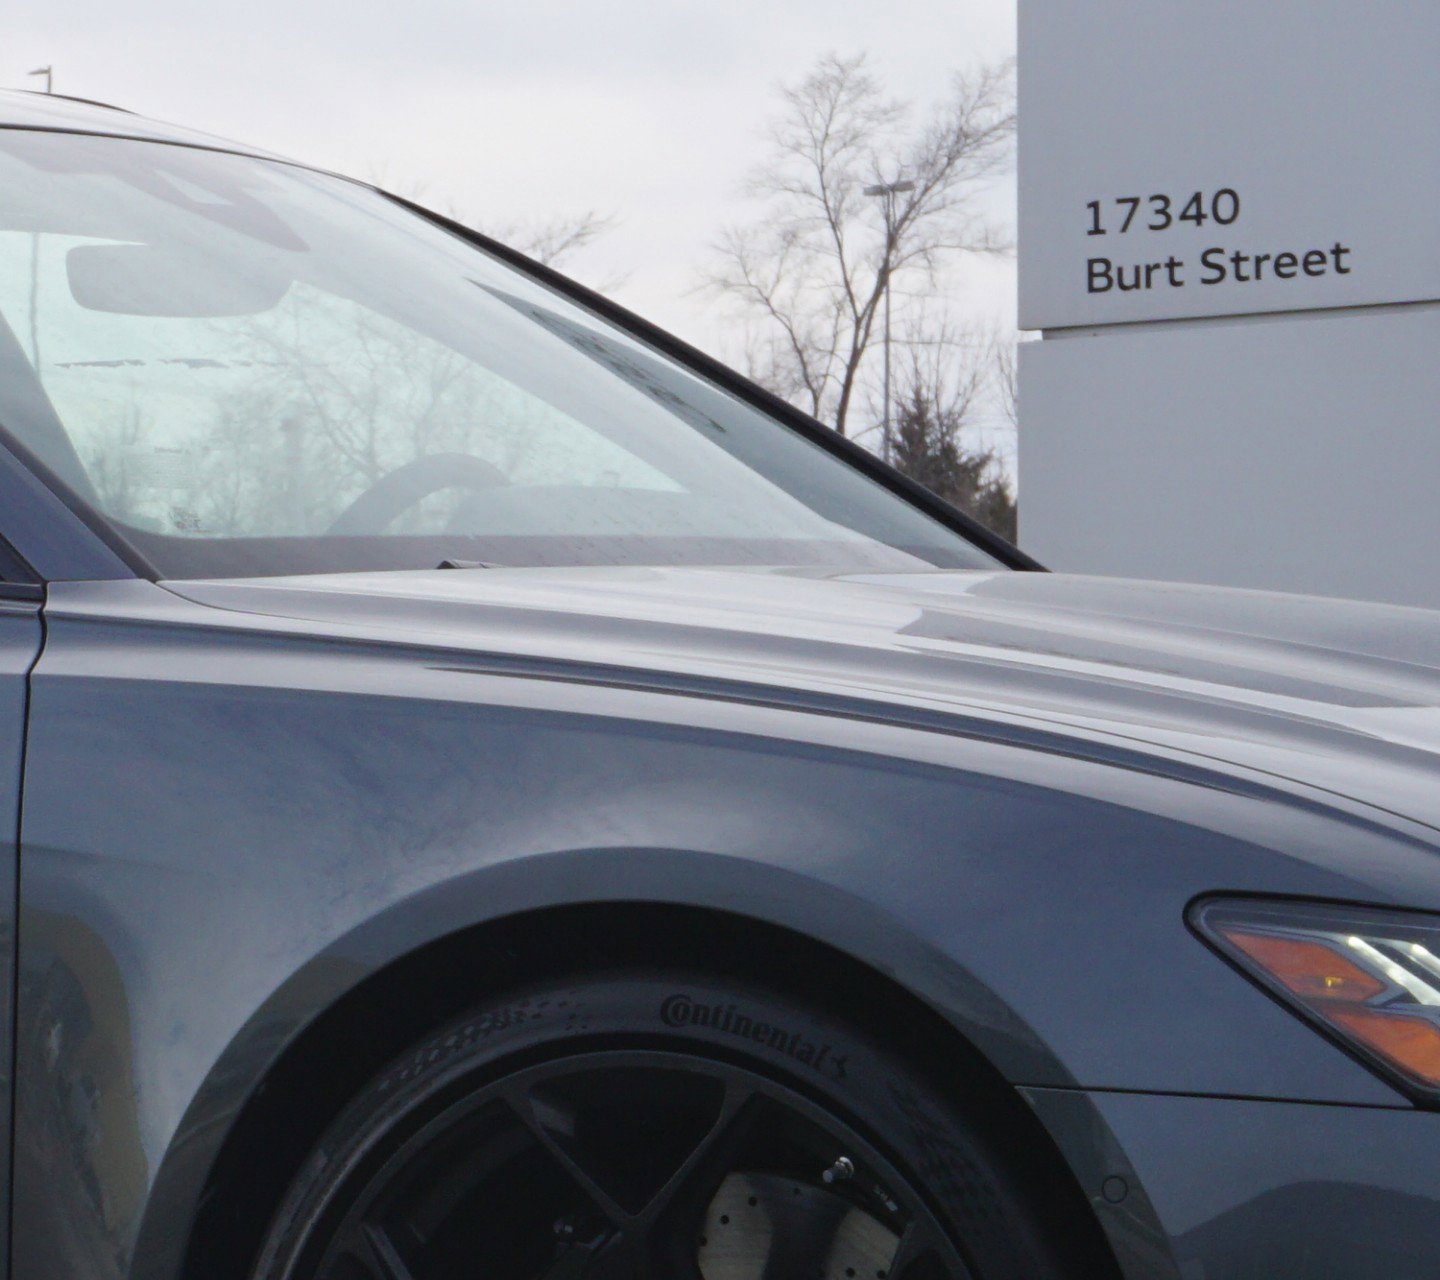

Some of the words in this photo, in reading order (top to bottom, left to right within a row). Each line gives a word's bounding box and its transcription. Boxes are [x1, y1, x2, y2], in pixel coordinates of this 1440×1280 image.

[1085, 188, 1241, 236] 17340
[1087, 255, 1184, 294] Burt
[1200, 242, 1351, 285] Street
[660, 994, 831, 1068] Continental
